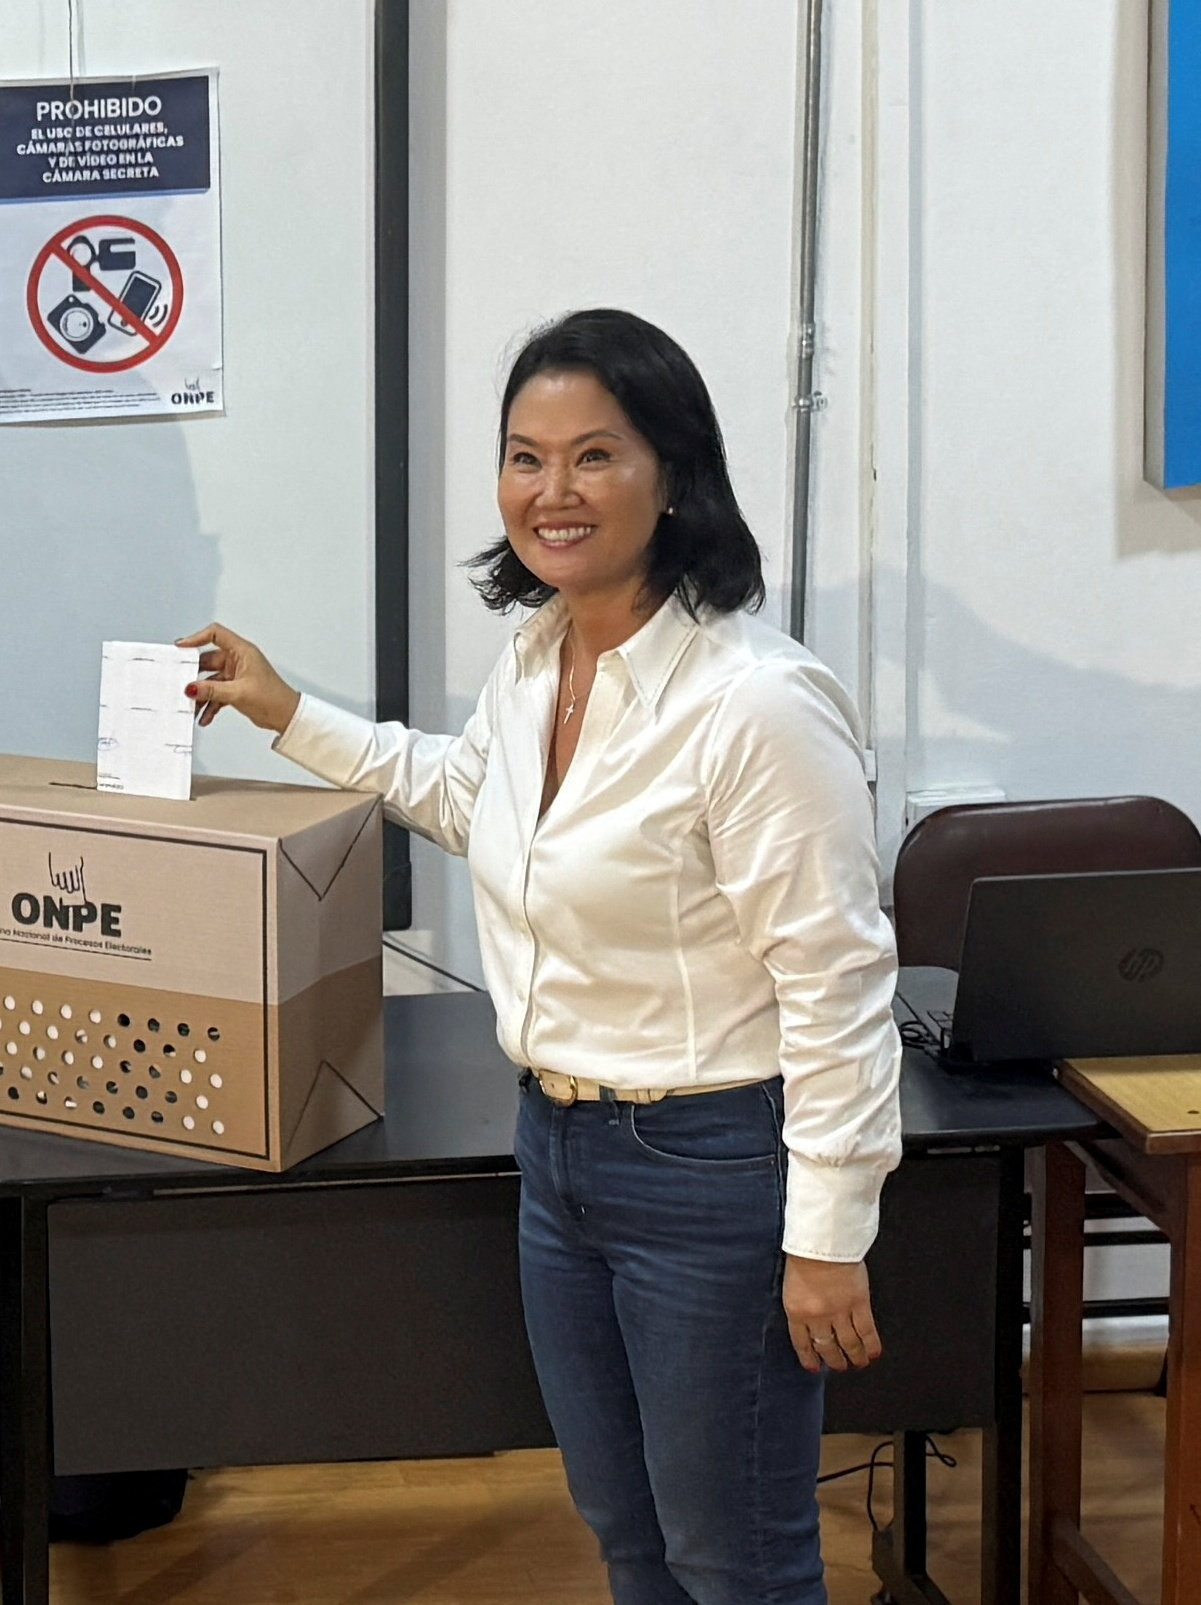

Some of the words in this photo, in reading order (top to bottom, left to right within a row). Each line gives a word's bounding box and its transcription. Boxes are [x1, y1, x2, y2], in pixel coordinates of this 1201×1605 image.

[36, 95, 162, 121] PROHIBIDO
[31, 128, 45, 140] EL
[76, 125, 93, 138] DE
[16, 139, 83, 155] CÁMARAS
[84, 135, 184, 152] FOTOGRÁFICAS
[48, 156, 58, 168] Y
[59, 156, 76, 168] DE
[119, 152, 136, 165] EN
[137, 151, 154, 164] LA
[42, 168, 100, 183] CÁMARA
[103, 165, 159, 180] SECRETA
[171, 391, 215, 405] ONPE
[11, 892, 122, 938] ONPE
